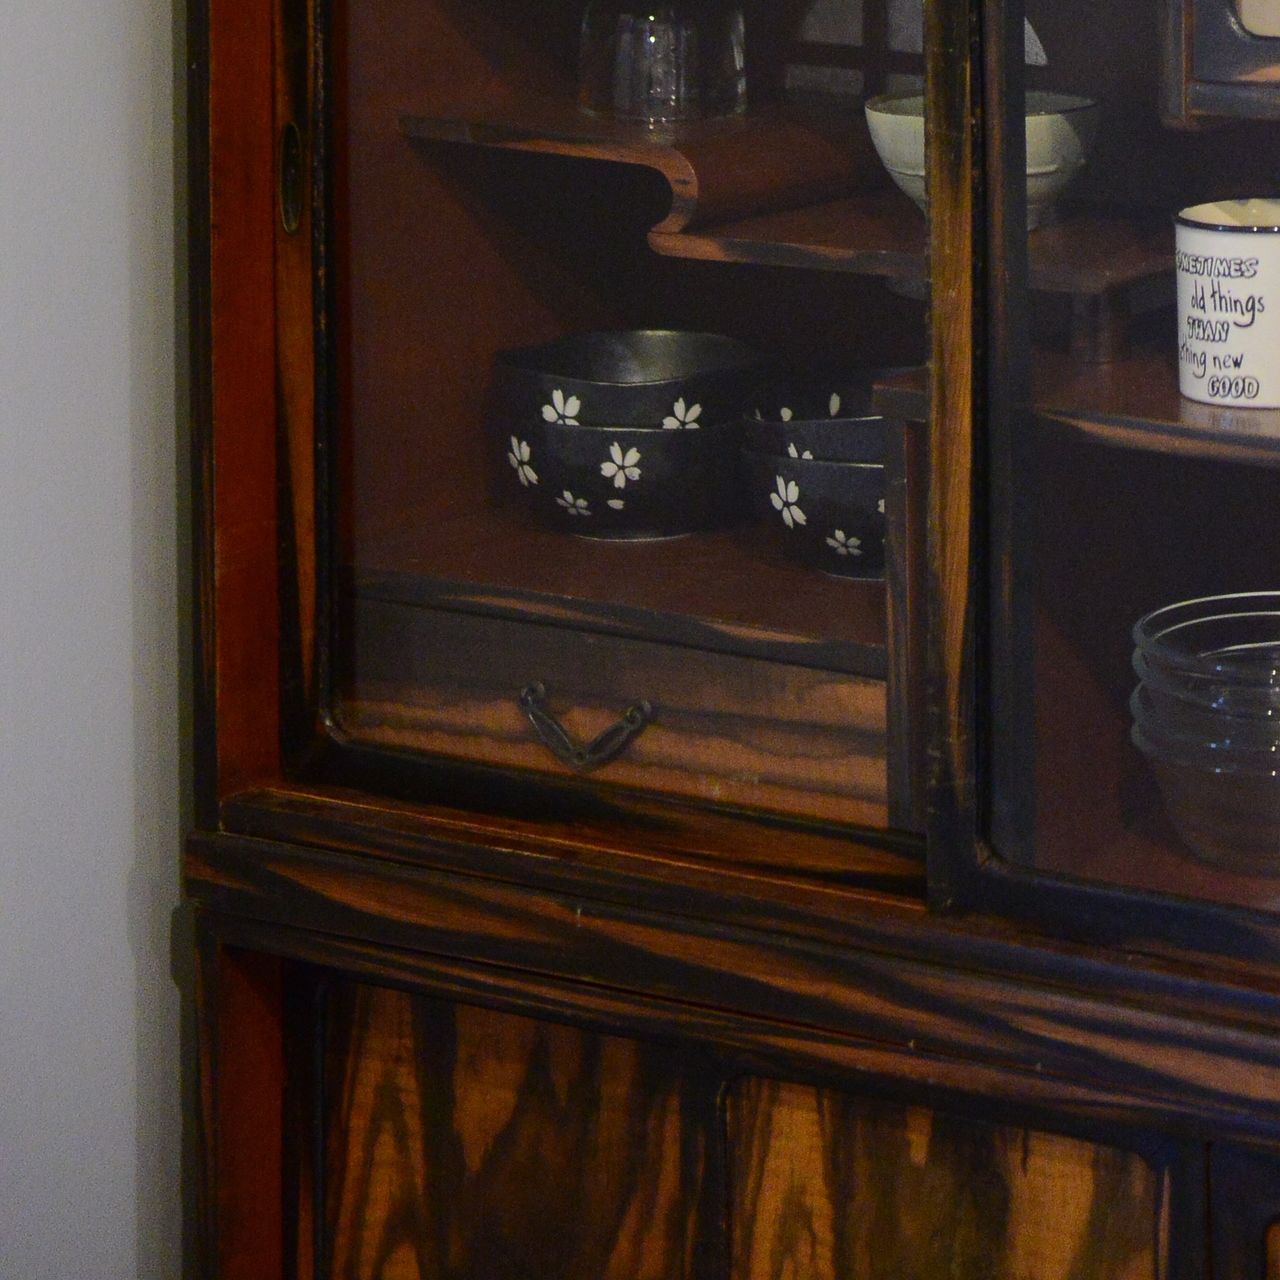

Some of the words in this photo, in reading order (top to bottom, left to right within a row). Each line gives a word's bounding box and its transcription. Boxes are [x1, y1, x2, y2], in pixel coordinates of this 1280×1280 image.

[1191, 280, 1206, 313] old
[1211, 279, 1265, 328] things
[1187, 316, 1229, 343] THAN
[1213, 352, 1244, 370] new
[1207, 374, 1260, 399] GOOD
